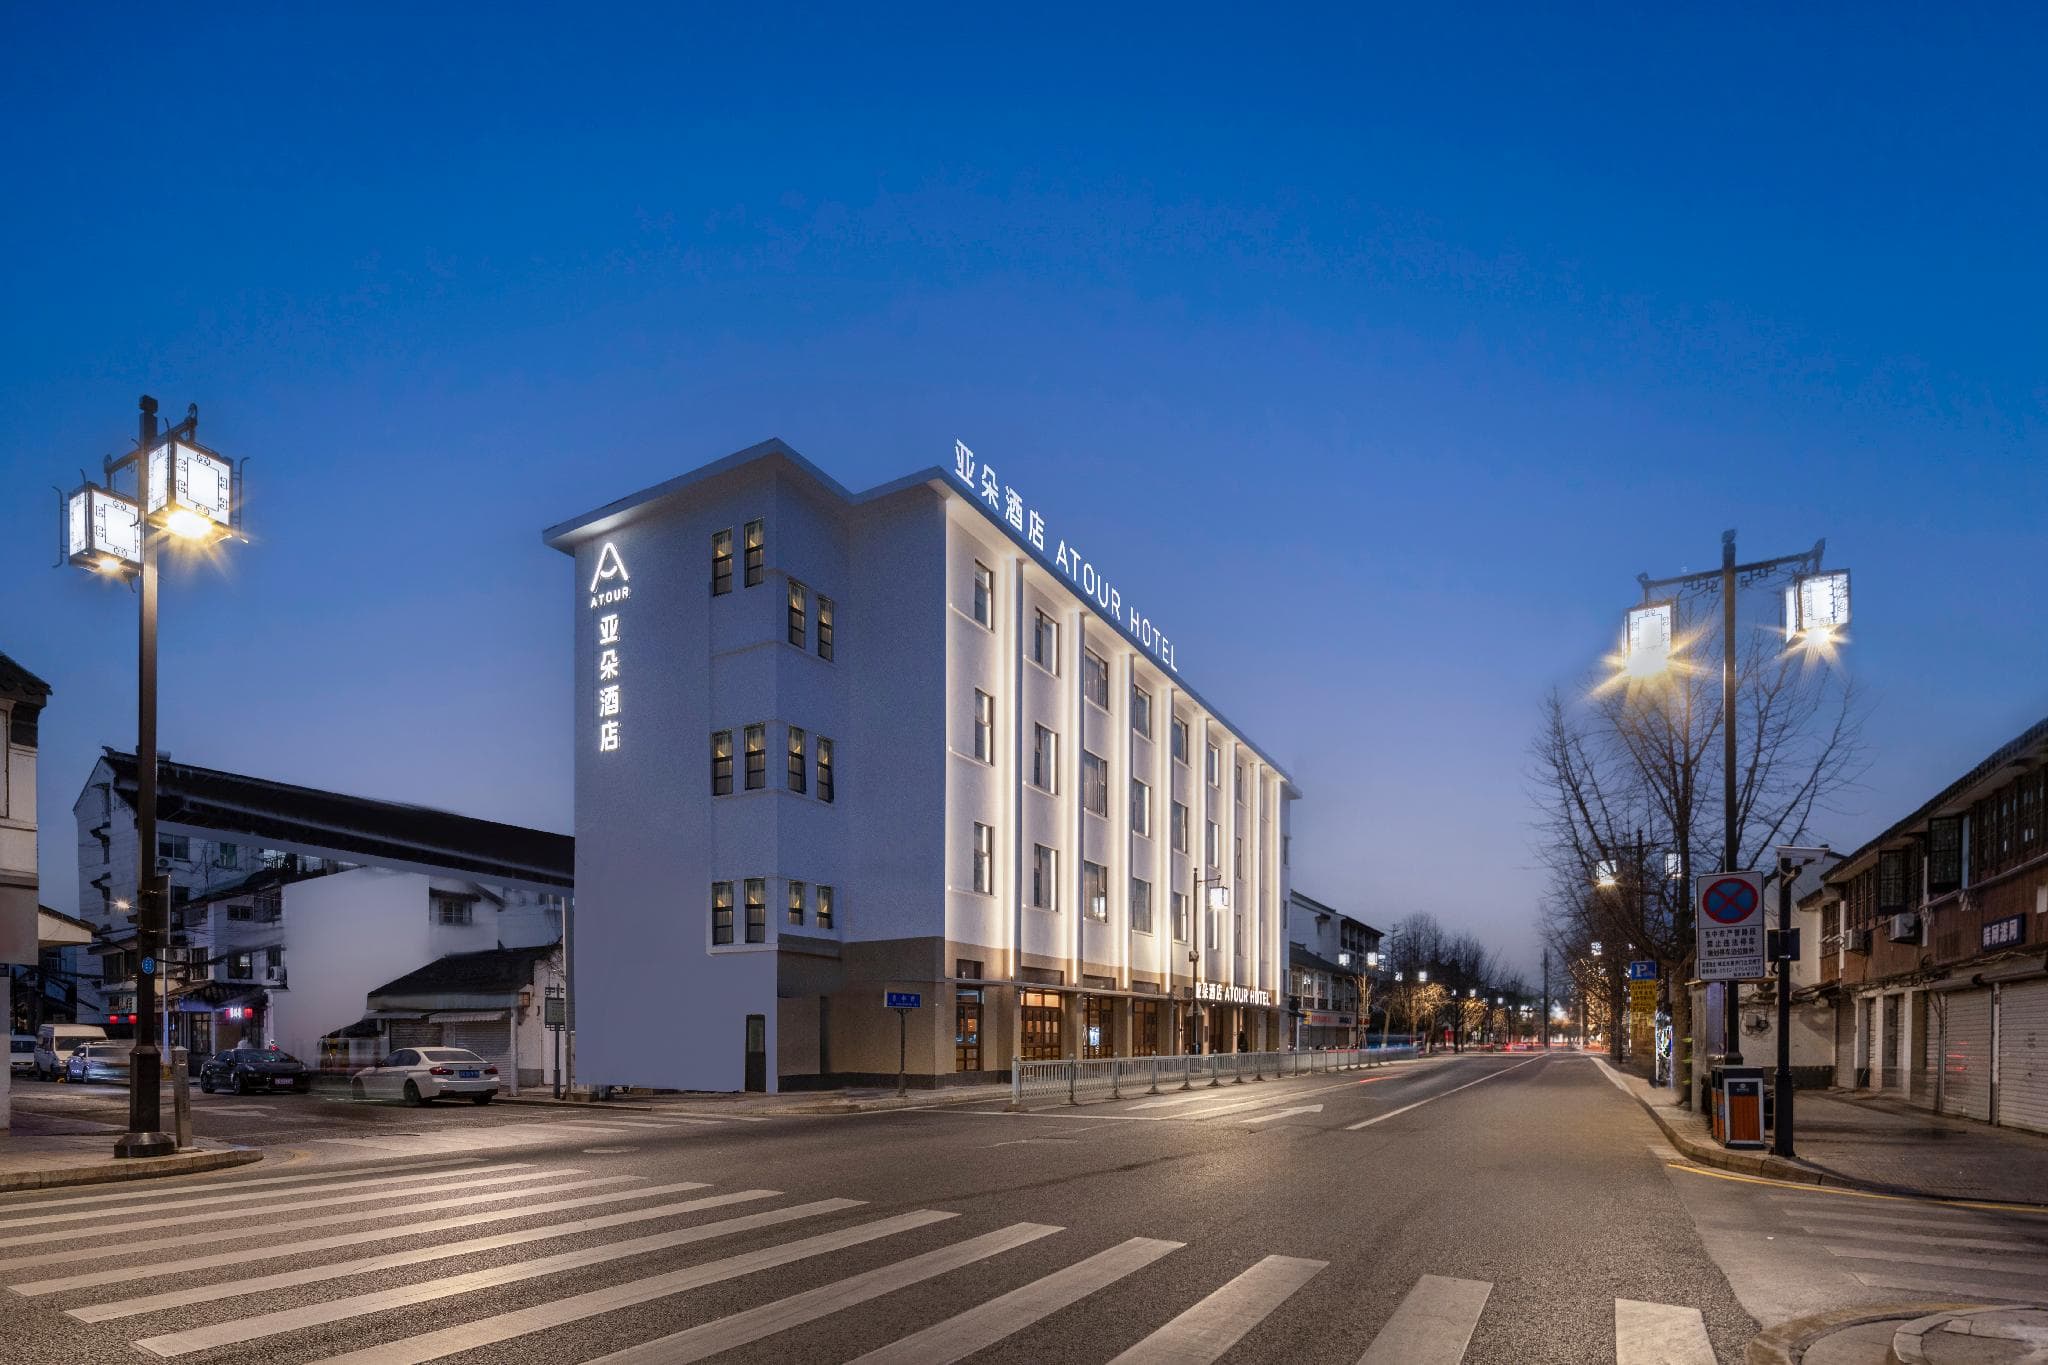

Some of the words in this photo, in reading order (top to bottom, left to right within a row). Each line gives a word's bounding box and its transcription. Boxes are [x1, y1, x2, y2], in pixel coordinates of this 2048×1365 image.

[955, 438, 1045, 551] 亚朵酒店
[1056, 539, 1121, 621] ATOUR
[1130, 606, 1178, 672] HOTEL
[590, 586, 630, 608] ATOUR
[600, 614, 620, 752] 亚朵酒店
[1225, 986, 1248, 1002] ATOUR
[1250, 989, 1270, 1005] HOTEL
